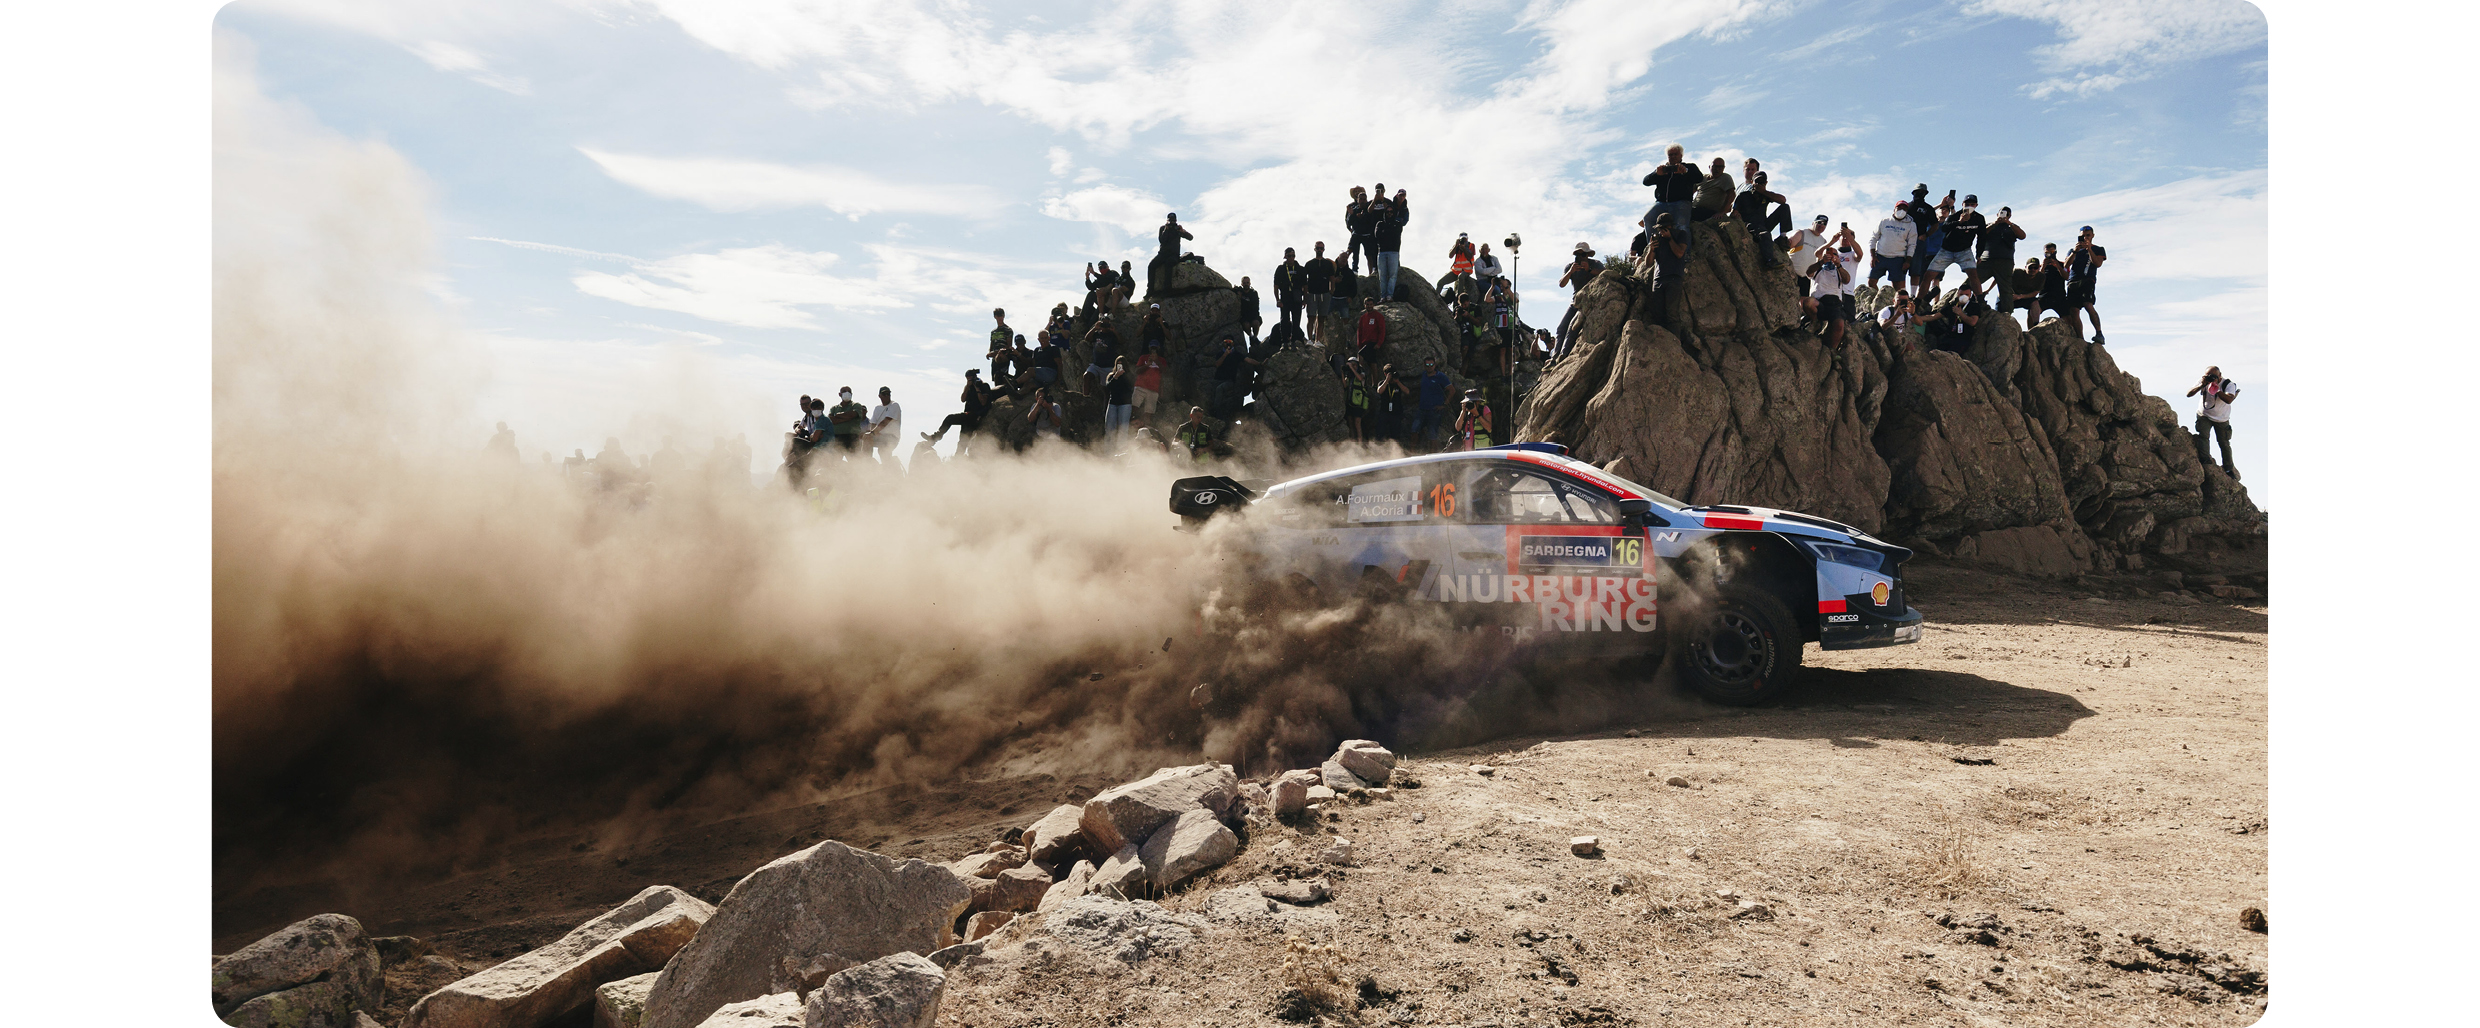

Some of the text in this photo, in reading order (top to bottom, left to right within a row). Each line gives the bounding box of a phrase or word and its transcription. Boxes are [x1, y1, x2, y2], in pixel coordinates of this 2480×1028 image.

[1539, 460, 1625, 495] motorsport.hyundai.com
[1335, 492, 1405, 506] A.Fourmaux
[1430, 483, 1456, 517] 16
[1571, 488, 1597, 504] HYUNDAI
[1360, 505, 1404, 517] A.Coria
[1311, 536, 1340, 546] WIA
[1524, 538, 1640, 566] SARDEGNA 16
[1440, 568, 1658, 603] NÜRBURG
[1541, 601, 1657, 633] RING
[1828, 614, 1859, 622] sparco
